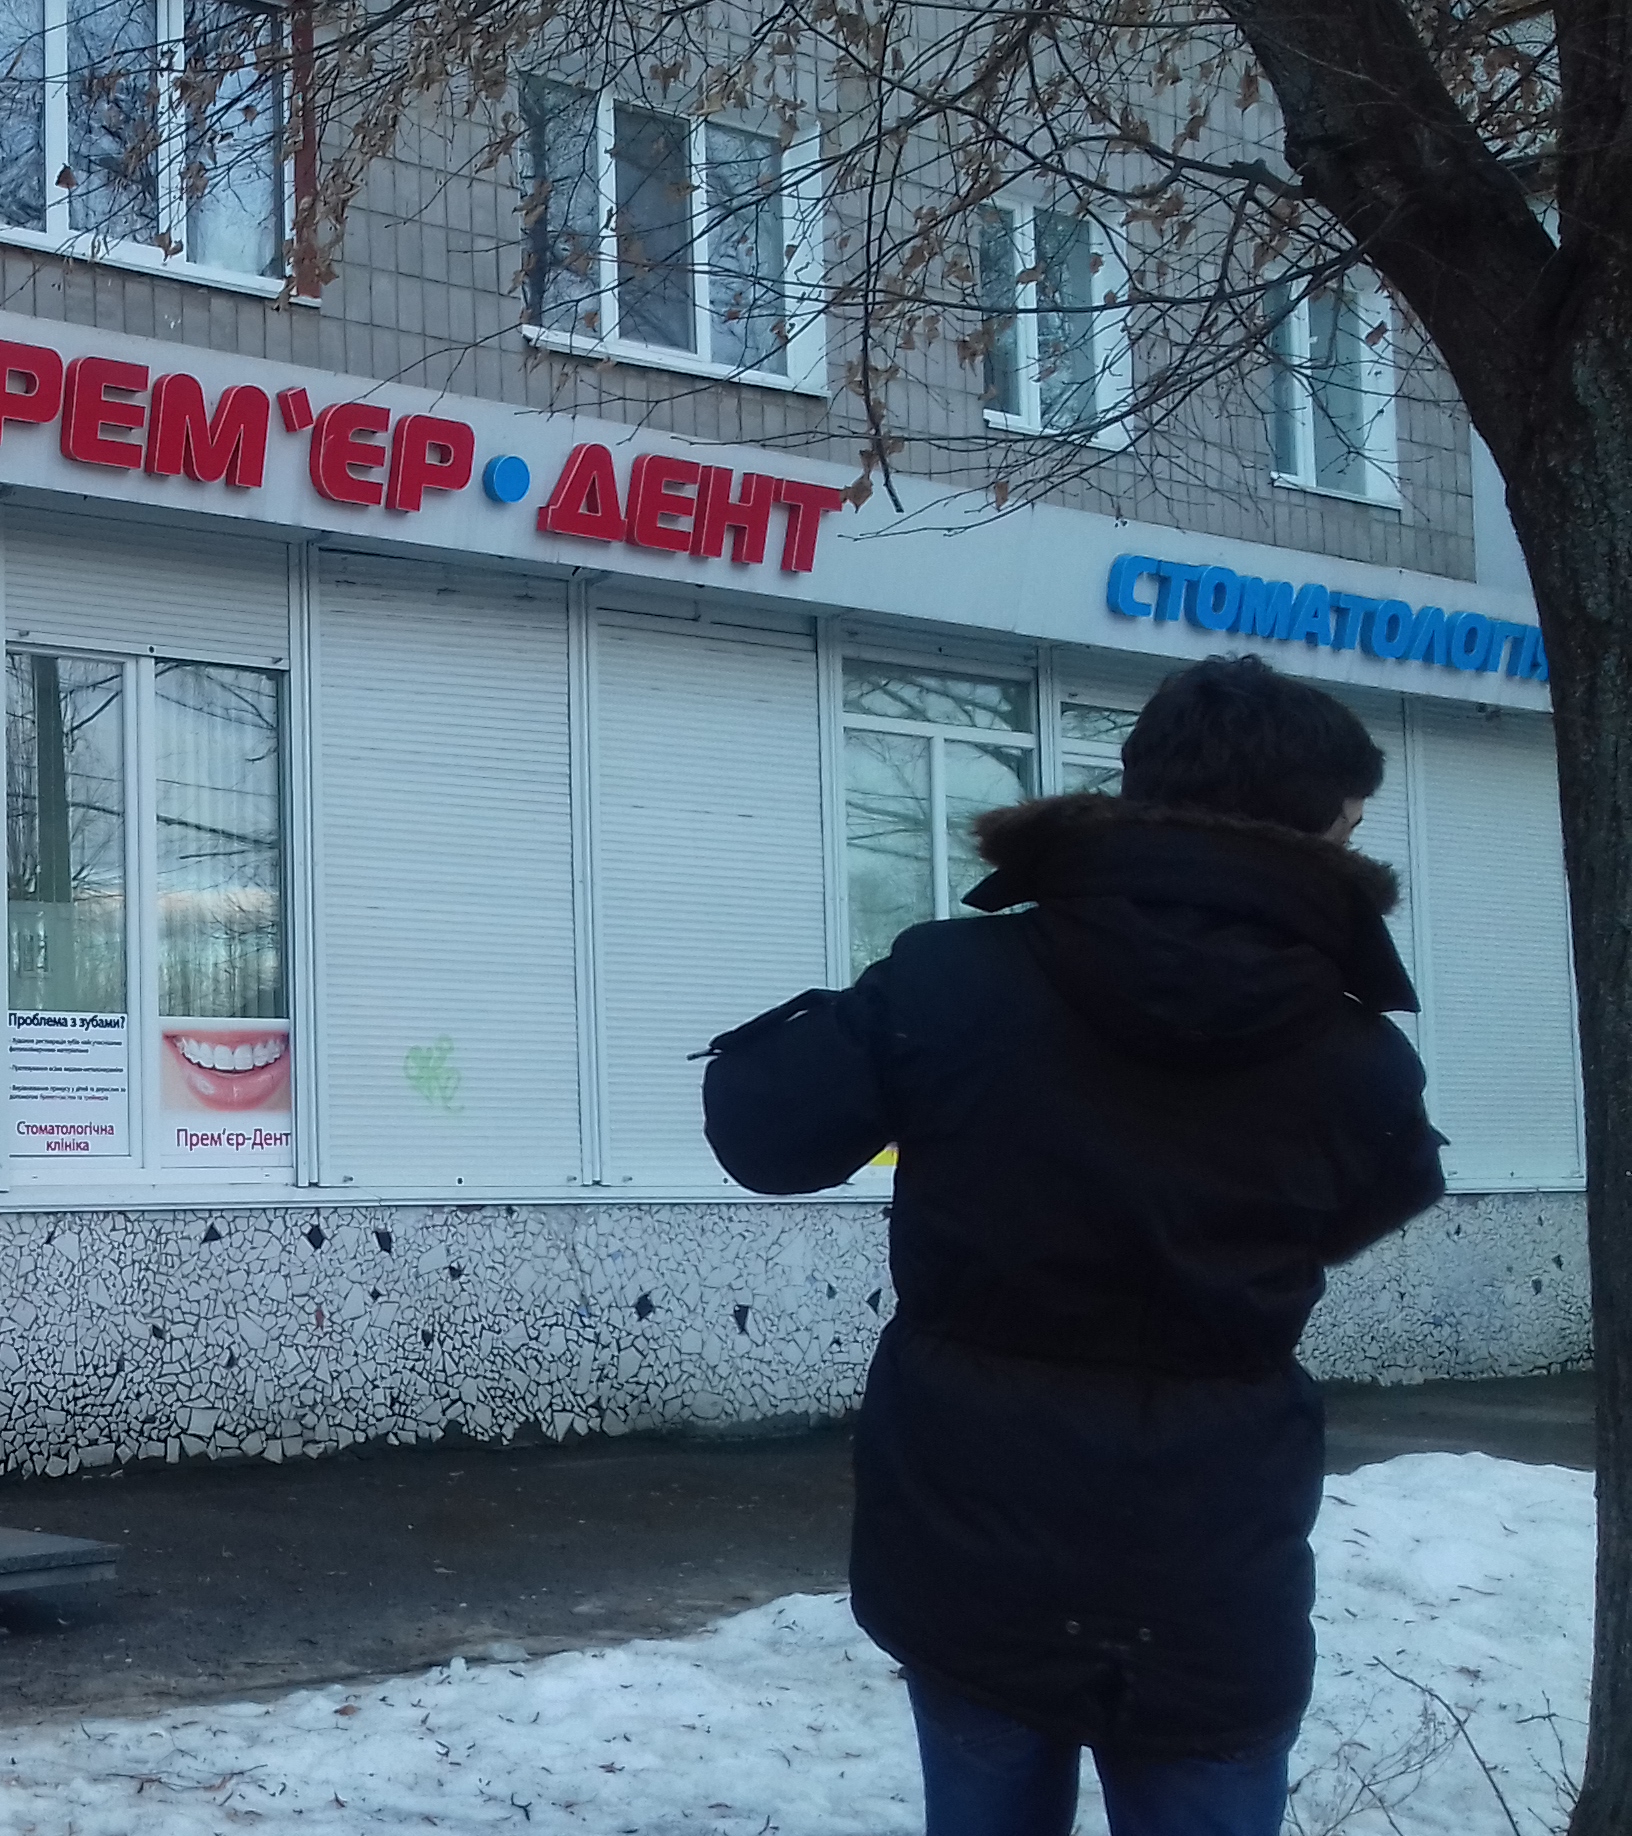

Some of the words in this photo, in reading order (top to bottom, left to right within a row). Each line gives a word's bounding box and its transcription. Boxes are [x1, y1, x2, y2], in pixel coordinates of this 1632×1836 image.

[536, 442, 844, 573] ДЕНТ
[8, 1012, 68, 1029] Проблема
[70, 1017, 77, 1027] з
[79, 1015, 126, 1031] зубами?
[16, 1120, 115, 1136] Стоматологічна
[46, 1137, 90, 1152] клініка
[176, 1127, 291, 1151] Прем'єр-Дент
